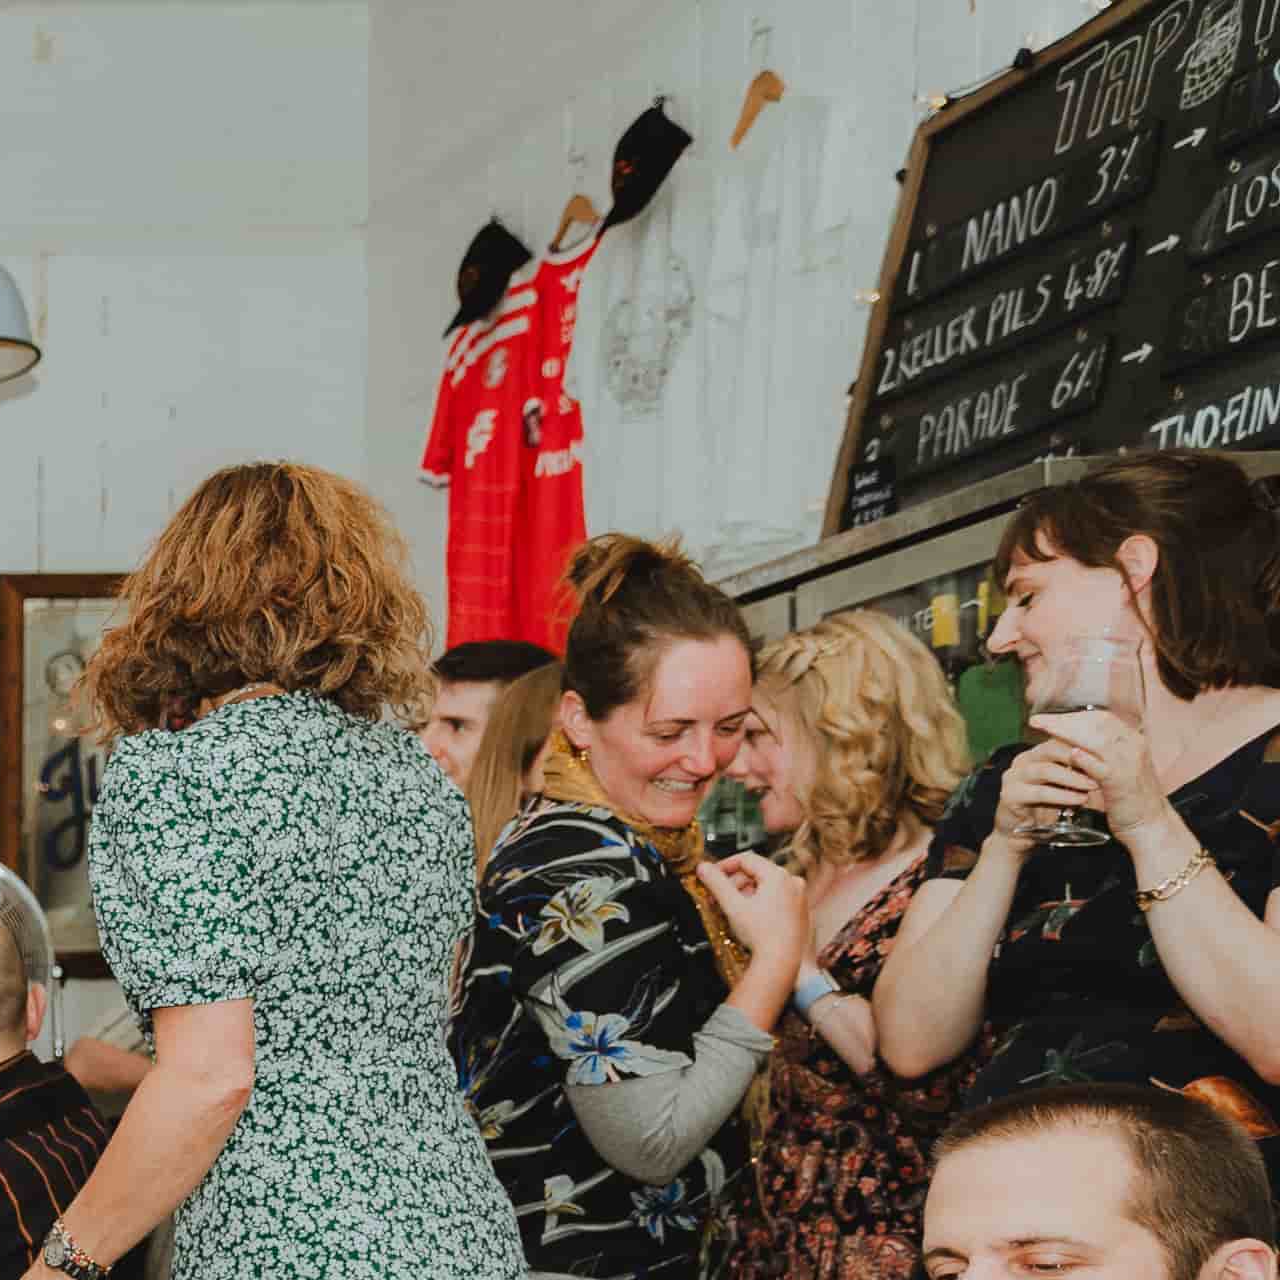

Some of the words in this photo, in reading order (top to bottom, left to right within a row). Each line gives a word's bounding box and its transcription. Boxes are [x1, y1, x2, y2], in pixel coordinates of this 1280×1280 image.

[1054, 0, 1192, 155] TAP
[961, 177, 1057, 271] NANO
[1088, 135, 1140, 206] 3%
[985, 274, 1053, 346] PILS
[918, 373, 1029, 465] PARADE
